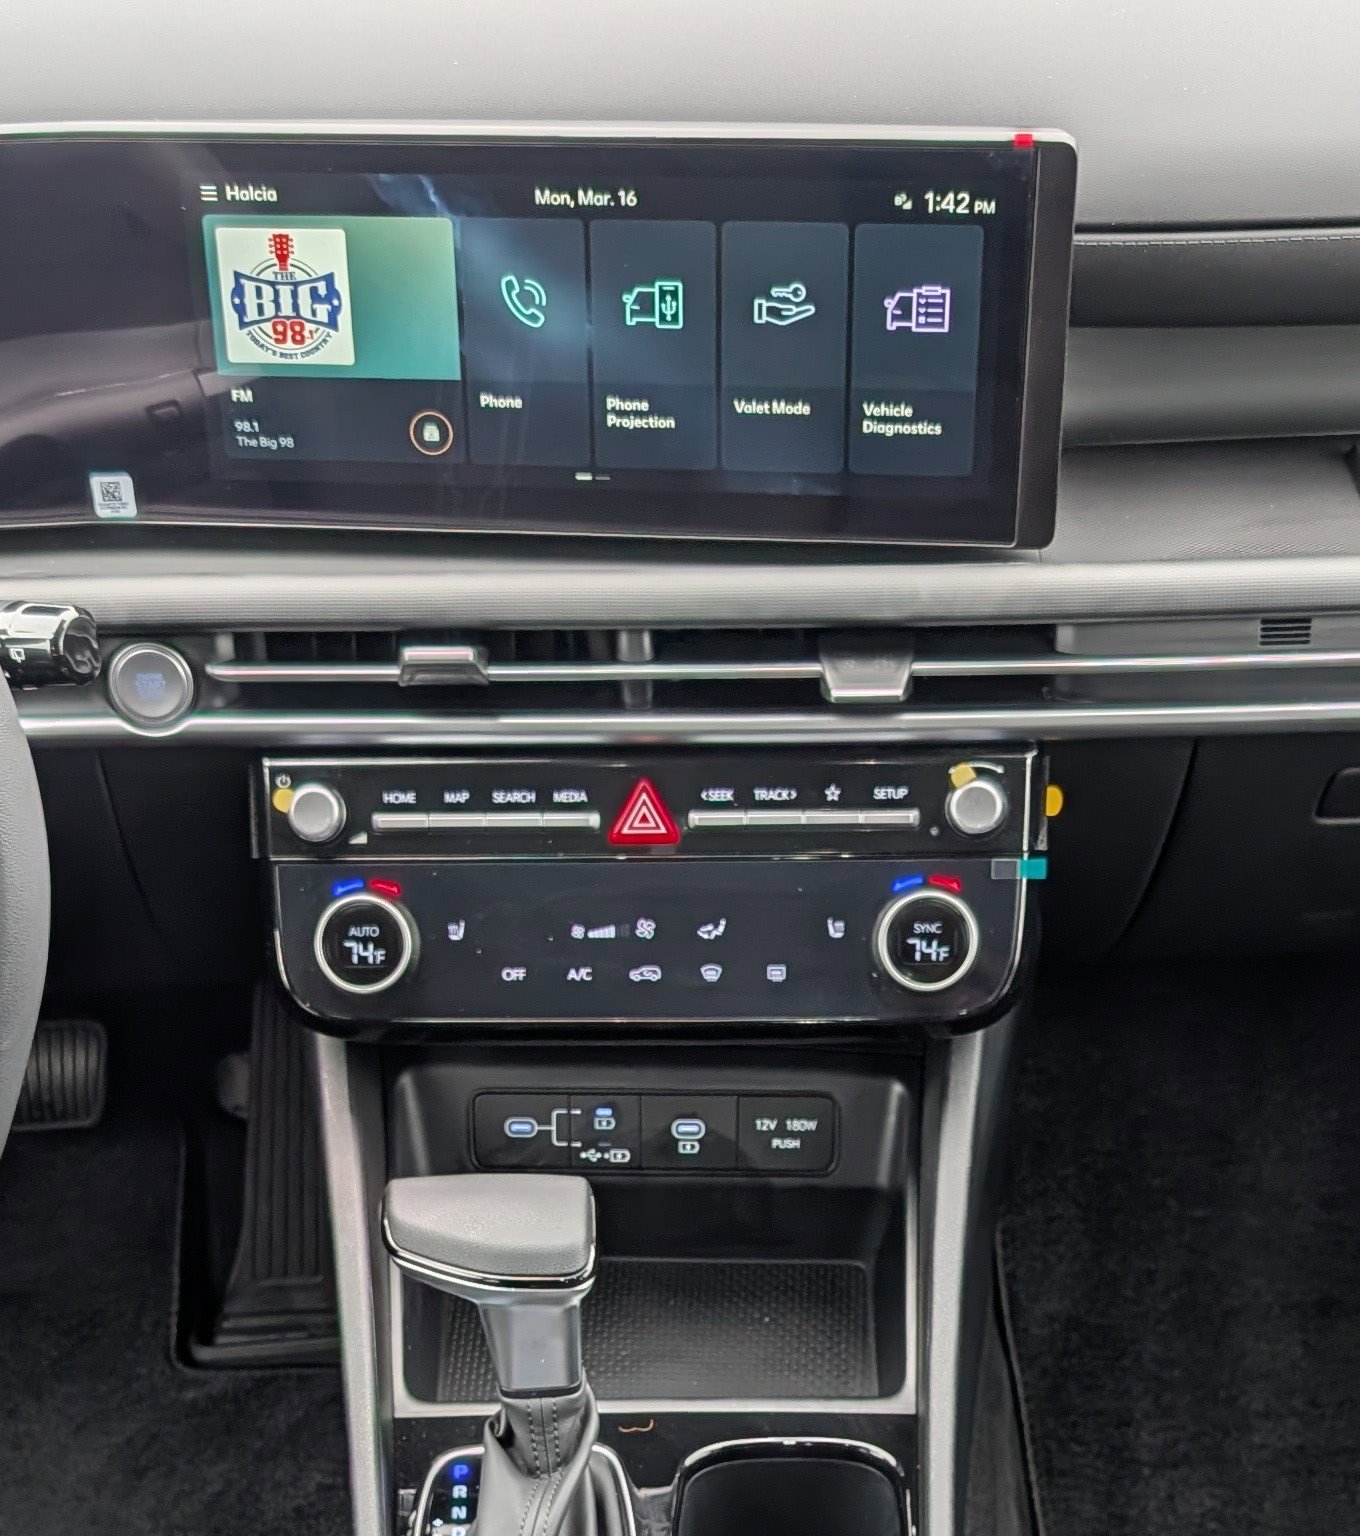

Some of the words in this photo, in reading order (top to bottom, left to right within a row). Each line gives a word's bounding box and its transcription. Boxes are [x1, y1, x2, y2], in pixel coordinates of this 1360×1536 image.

[534, 186, 575, 209] Mon,
[577, 187, 615, 207] Mar.
[617, 188, 638, 207] 16
[924, 190, 971, 214] 1:42
[973, 199, 996, 214] PM
[273, 270, 297, 280] THE
[239, 278, 333, 324] BIG
[230, 388, 253, 403] FM
[479, 392, 522, 409] Phone
[606, 395, 650, 412] Phone
[733, 399, 771, 415] Valet
[771, 400, 811, 416] Mode
[862, 402, 913, 418] Vehicle
[234, 419, 260, 433] 98.1
[606, 412, 676, 430] Projection
[862, 419, 942, 437] Diagnostics
[382, 789, 417, 804] HOME
[443, 789, 470, 804] MAP
[491, 789, 536, 804] SEARCH
[552, 788, 589, 803] MEDIA
[873, 785, 909, 800] SETUP
[348, 924, 380, 938] AUTO
[913, 920, 943, 934] SYNC
[501, 966, 527, 981] OFF
[566, 966, 593, 981] A/C
[755, 1118, 778, 1131] 12V
[771, 1137, 801, 1149] PUSH
[452, 1463, 470, 1480] P
[452, 1484, 469, 1499] R
[450, 1506, 468, 1520] N
